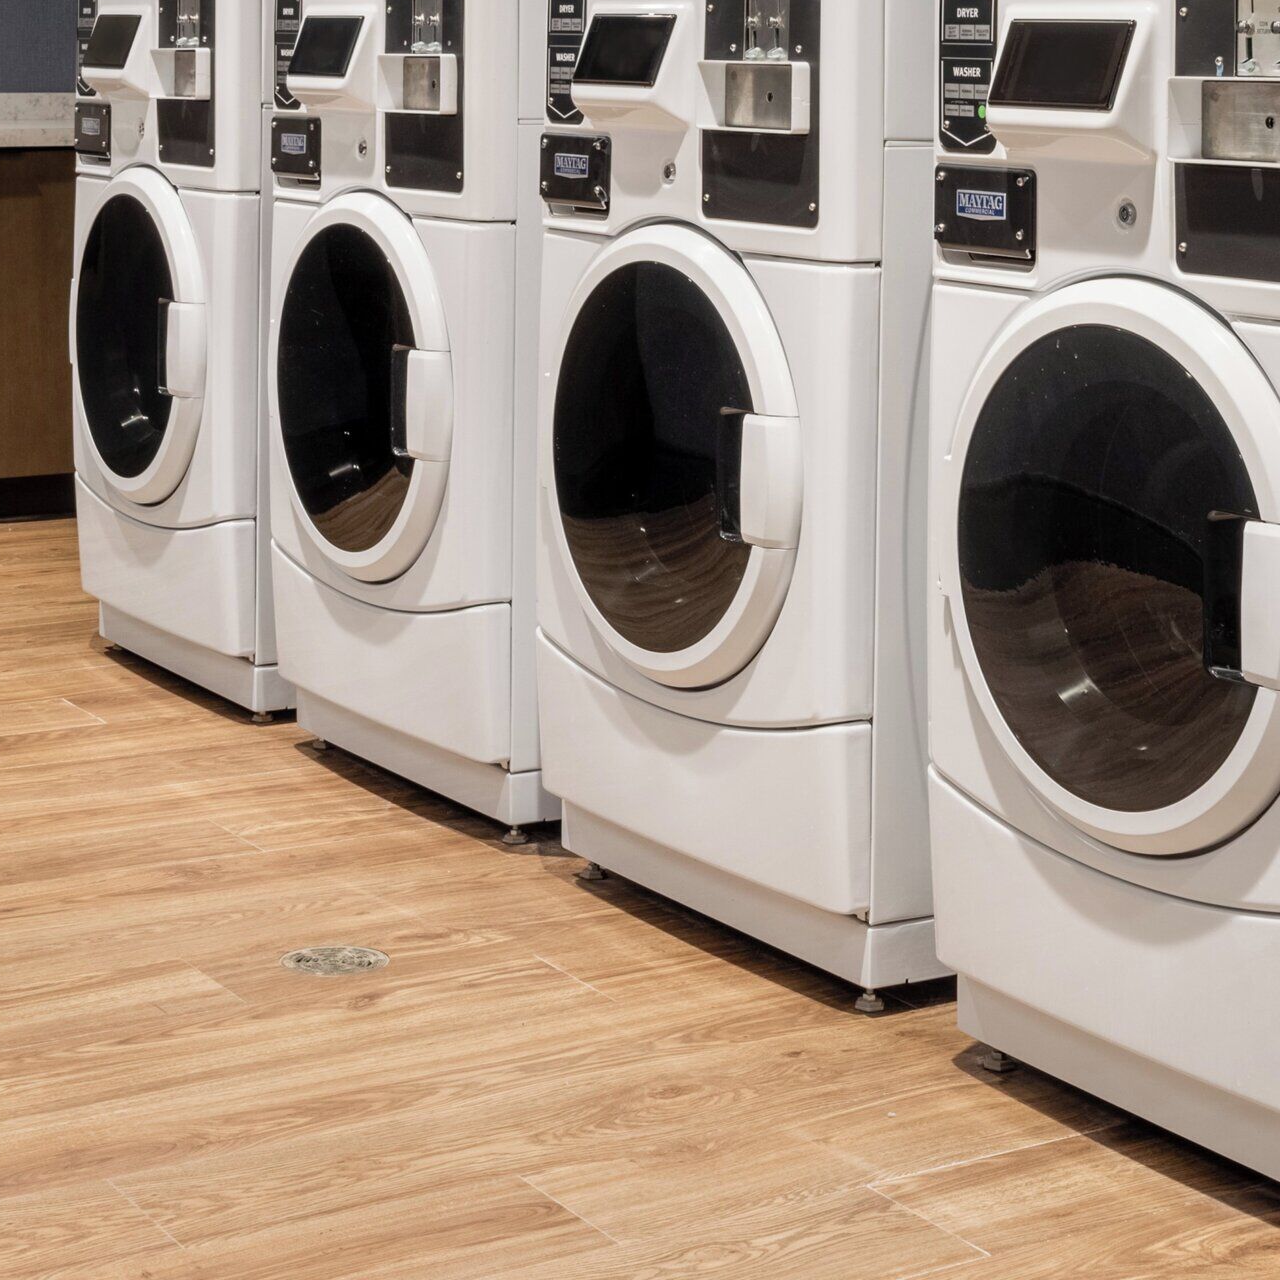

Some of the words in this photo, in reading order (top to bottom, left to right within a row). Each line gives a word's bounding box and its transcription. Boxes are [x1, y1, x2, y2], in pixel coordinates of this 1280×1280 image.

[559, 4, 575, 13] DRYER
[956, 7, 979, 18] DRYER
[952, 66, 981, 78] WASHER
[556, 156, 586, 170] MAYTAG
[959, 193, 1003, 210] MAYTAG
[964, 207, 995, 216] COMMERCIAL
